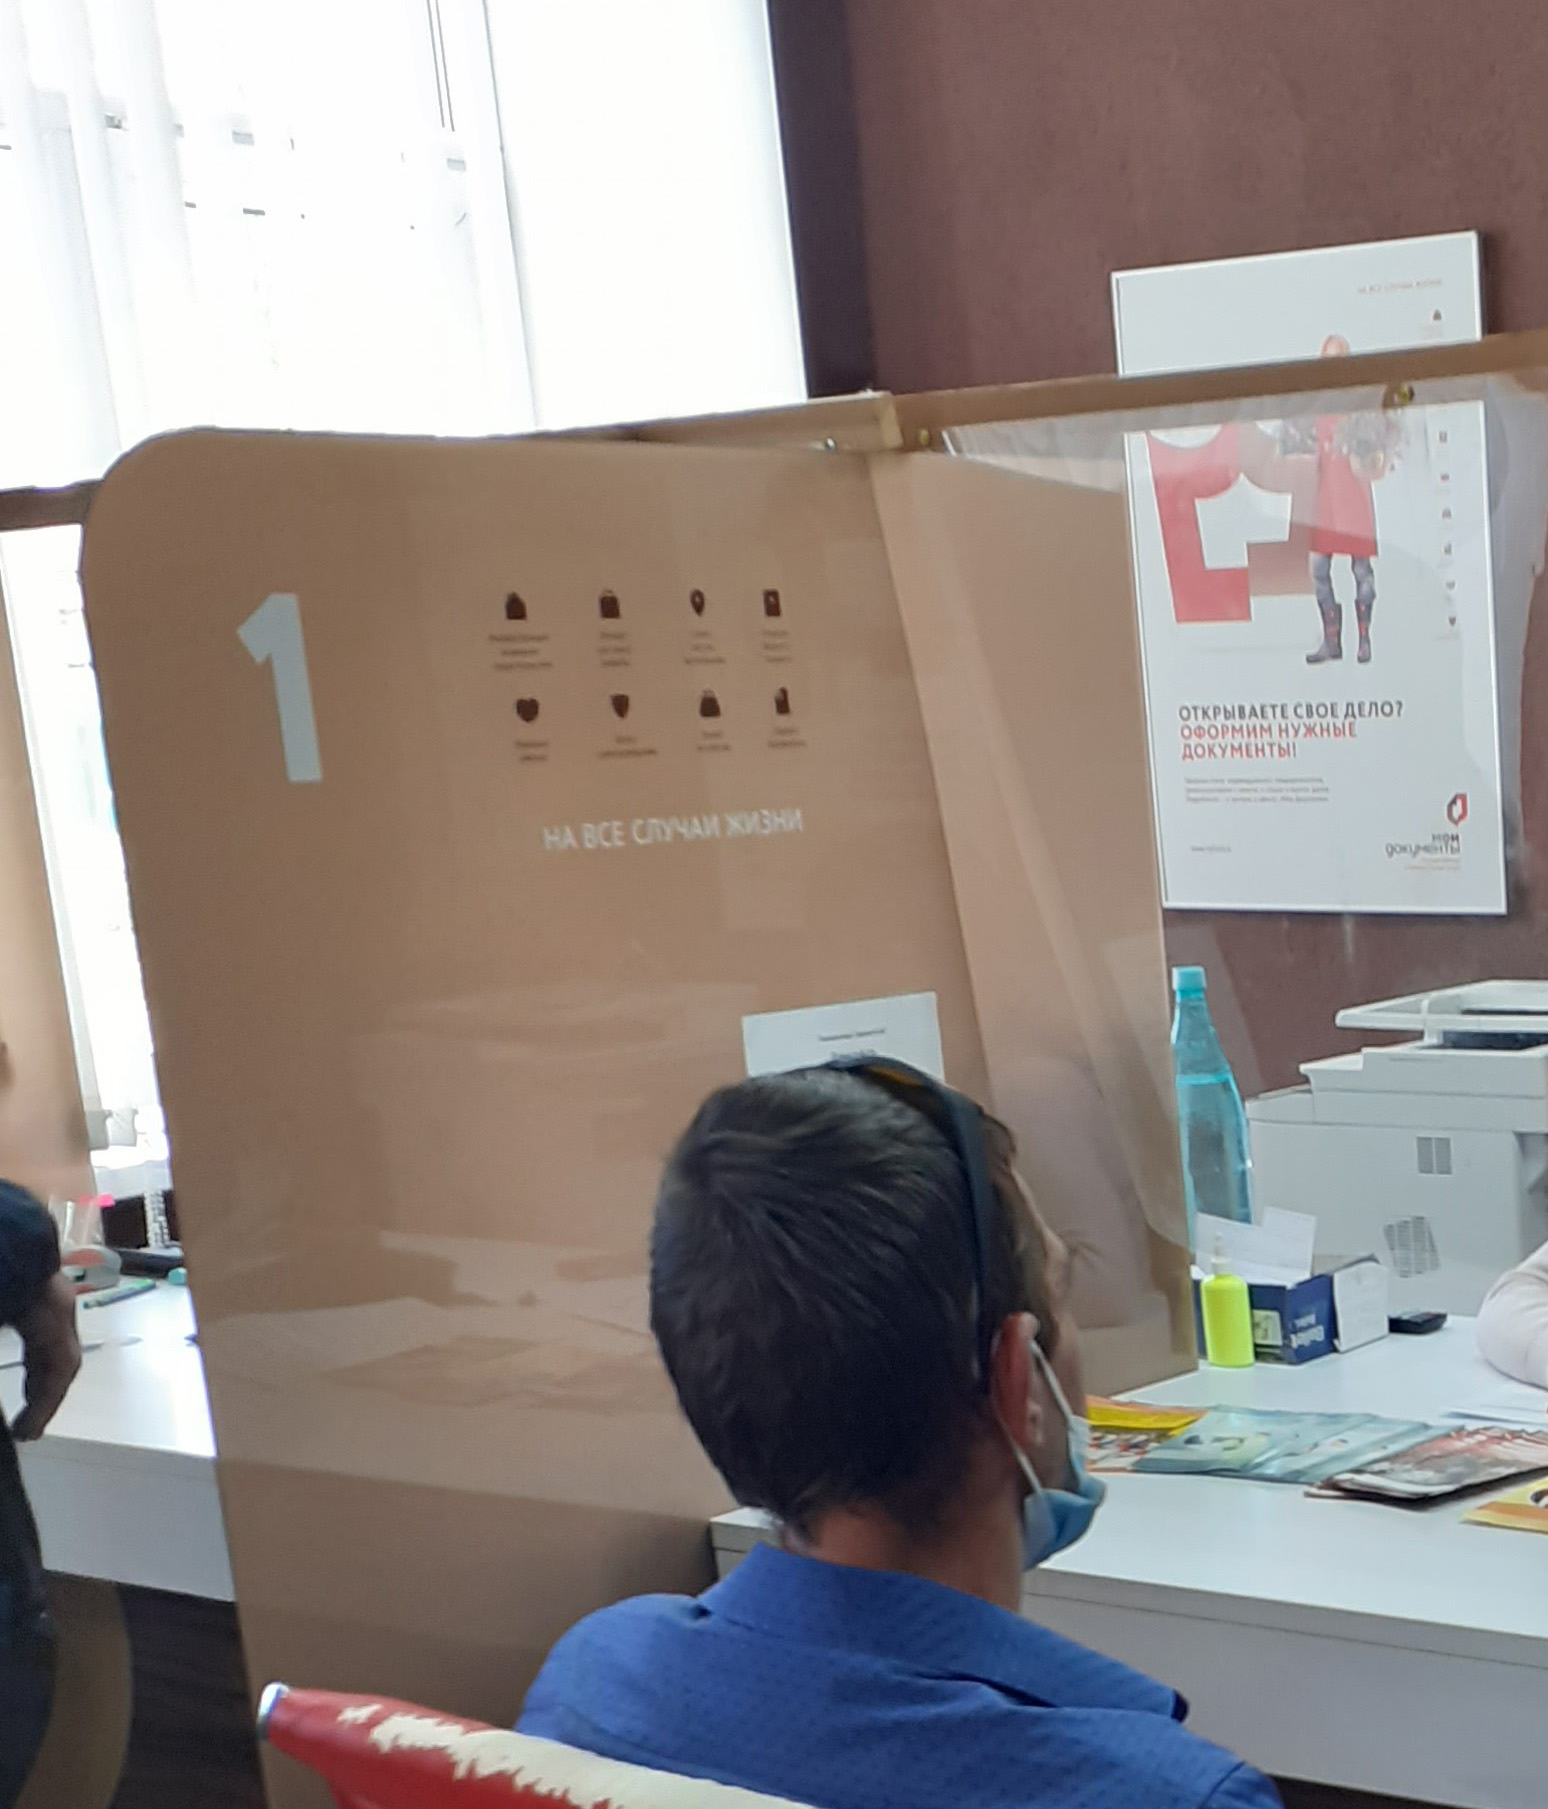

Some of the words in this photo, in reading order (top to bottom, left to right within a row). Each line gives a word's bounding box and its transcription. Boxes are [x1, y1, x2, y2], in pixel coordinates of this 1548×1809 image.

[236, 592, 323, 782] 1
[1178, 703, 1290, 722] ОТКРЫВАЕТЕ
[1293, 702, 1340, 720] СВОЕ
[1344, 700, 1404, 720] ДЕЛО?
[1180, 723, 1274, 741] ОФОРМИМ
[1277, 721, 1357, 740] НУЖНЫЕ
[1181, 742, 1298, 762] ДОКУМЕНТЫ!
[543, 825, 577, 849] НА
[581, 820, 626, 849] ВСЕ
[631, 813, 721, 846] СЛУЧАИ
[724, 807, 803, 838] ЖИЗНИ
